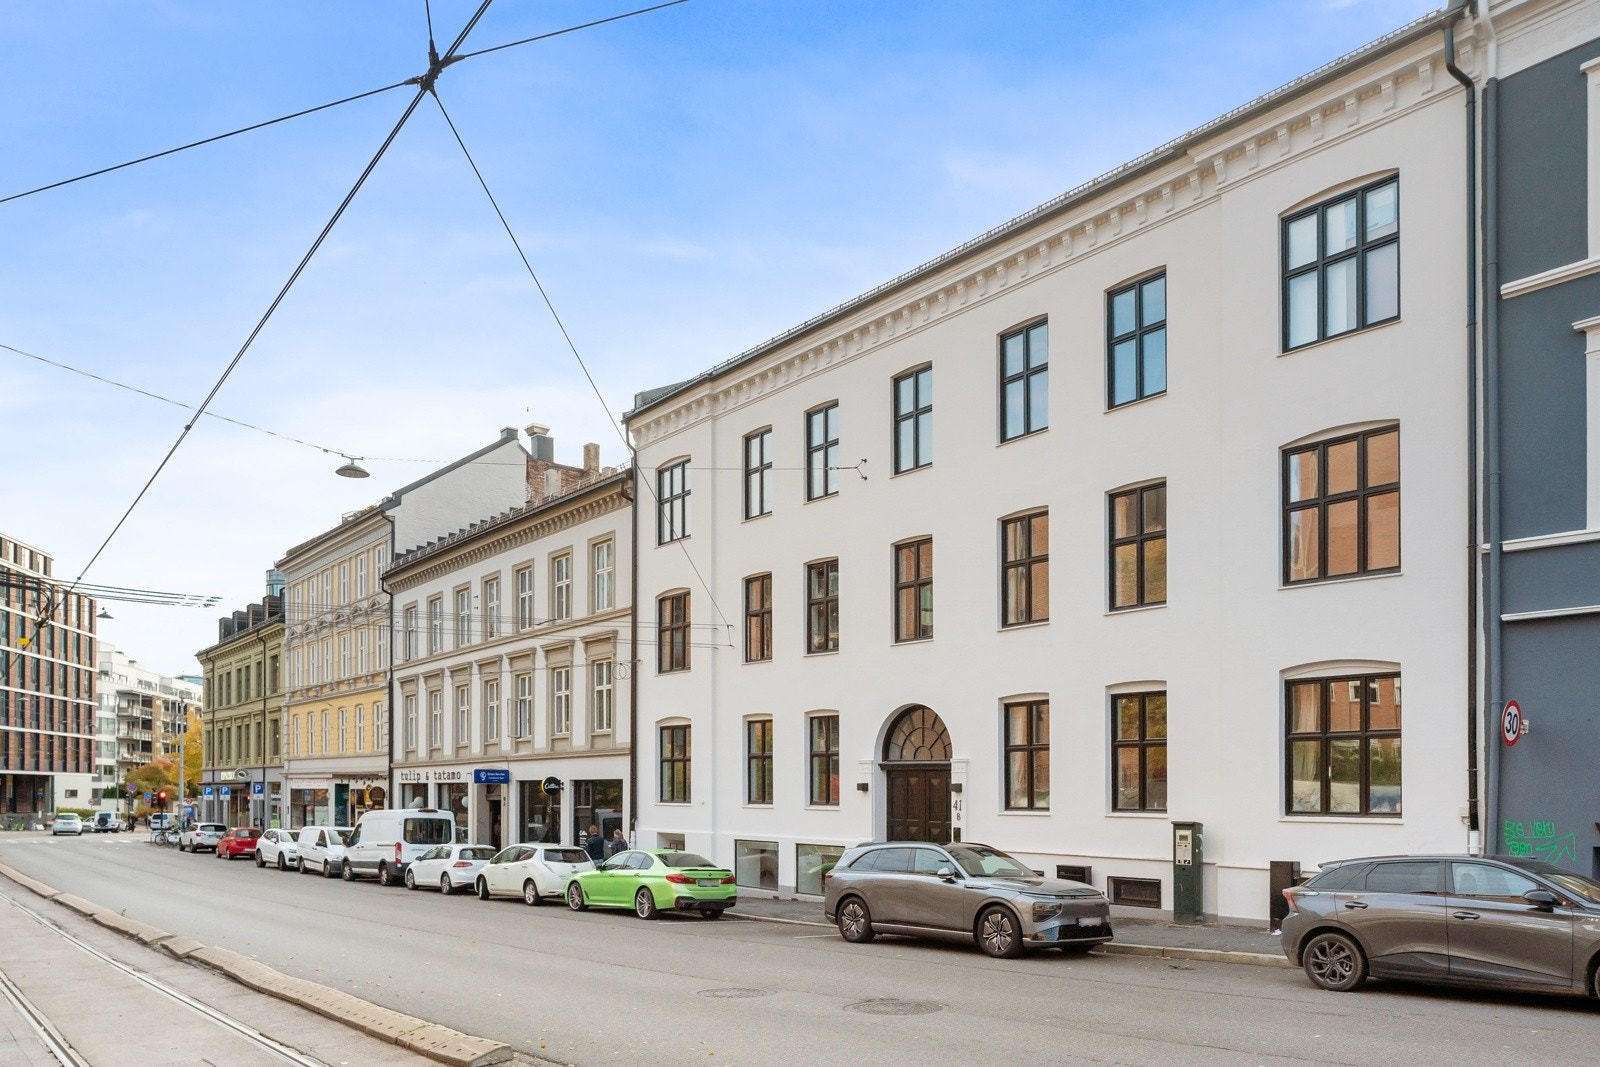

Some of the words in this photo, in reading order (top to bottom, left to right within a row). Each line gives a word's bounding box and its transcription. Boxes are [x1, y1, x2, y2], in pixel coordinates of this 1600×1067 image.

[1505, 711, 1518, 735] 30
[400, 770, 421, 783] tulip
[433, 769, 462, 780] tatamo
[952, 799, 962, 812] 41
[956, 812, 962, 821] B
